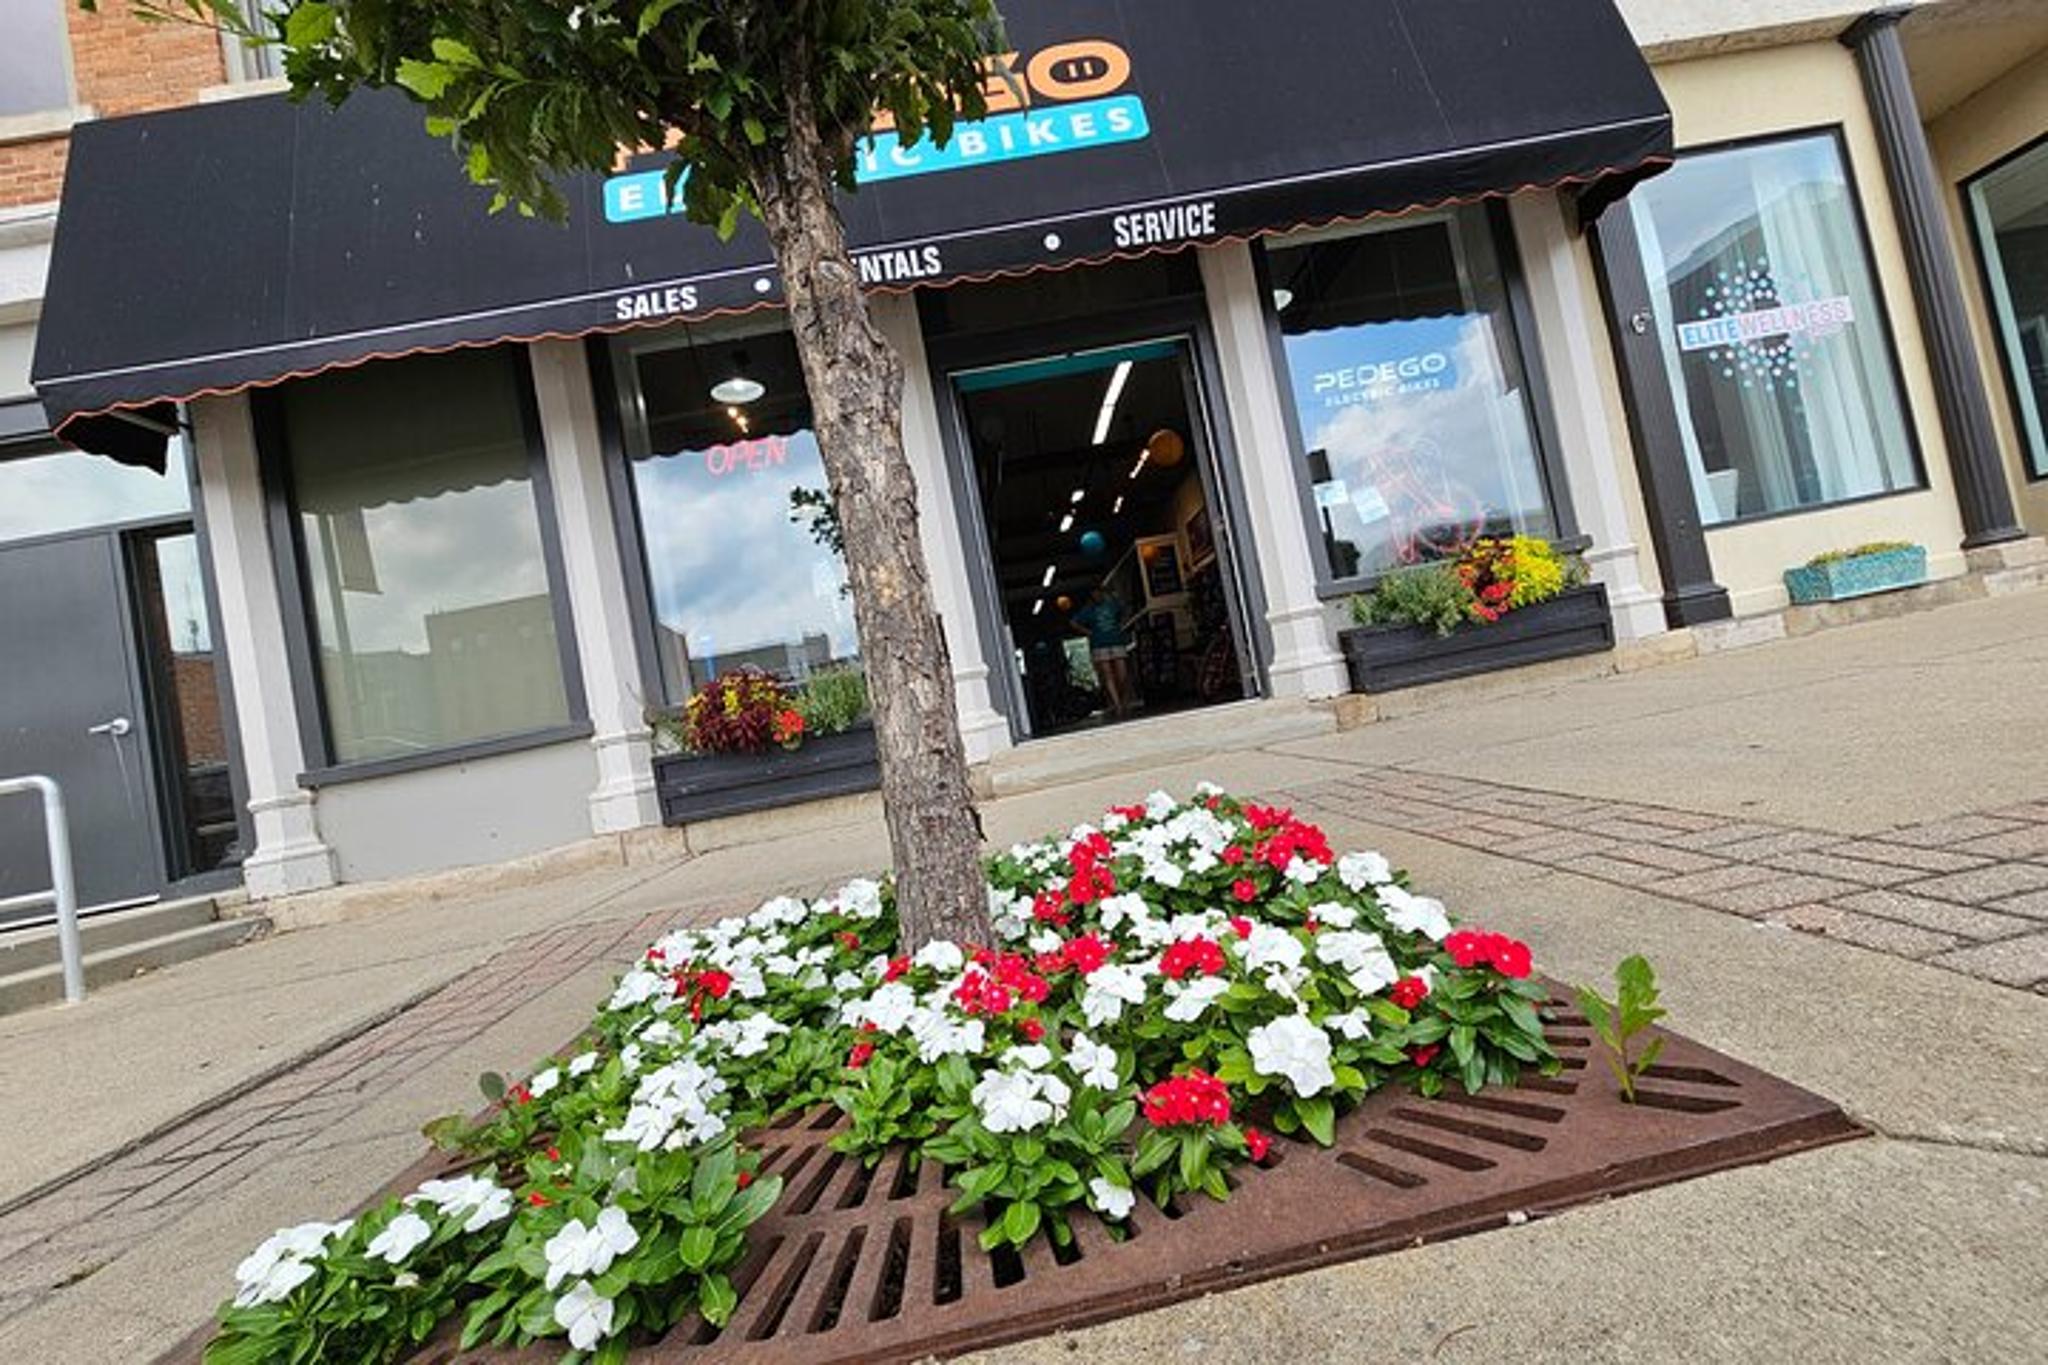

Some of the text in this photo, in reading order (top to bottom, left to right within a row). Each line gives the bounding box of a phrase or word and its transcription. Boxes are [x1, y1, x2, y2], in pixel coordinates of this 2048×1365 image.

[959, 106, 1133, 157] BIKES
[1113, 202, 1216, 248] SERVICE
[851, 246, 942, 282] NTALS
[616, 285, 698, 320] SALES
[1314, 352, 1447, 394] PEDEGO
[704, 435, 788, 475] OPEN
